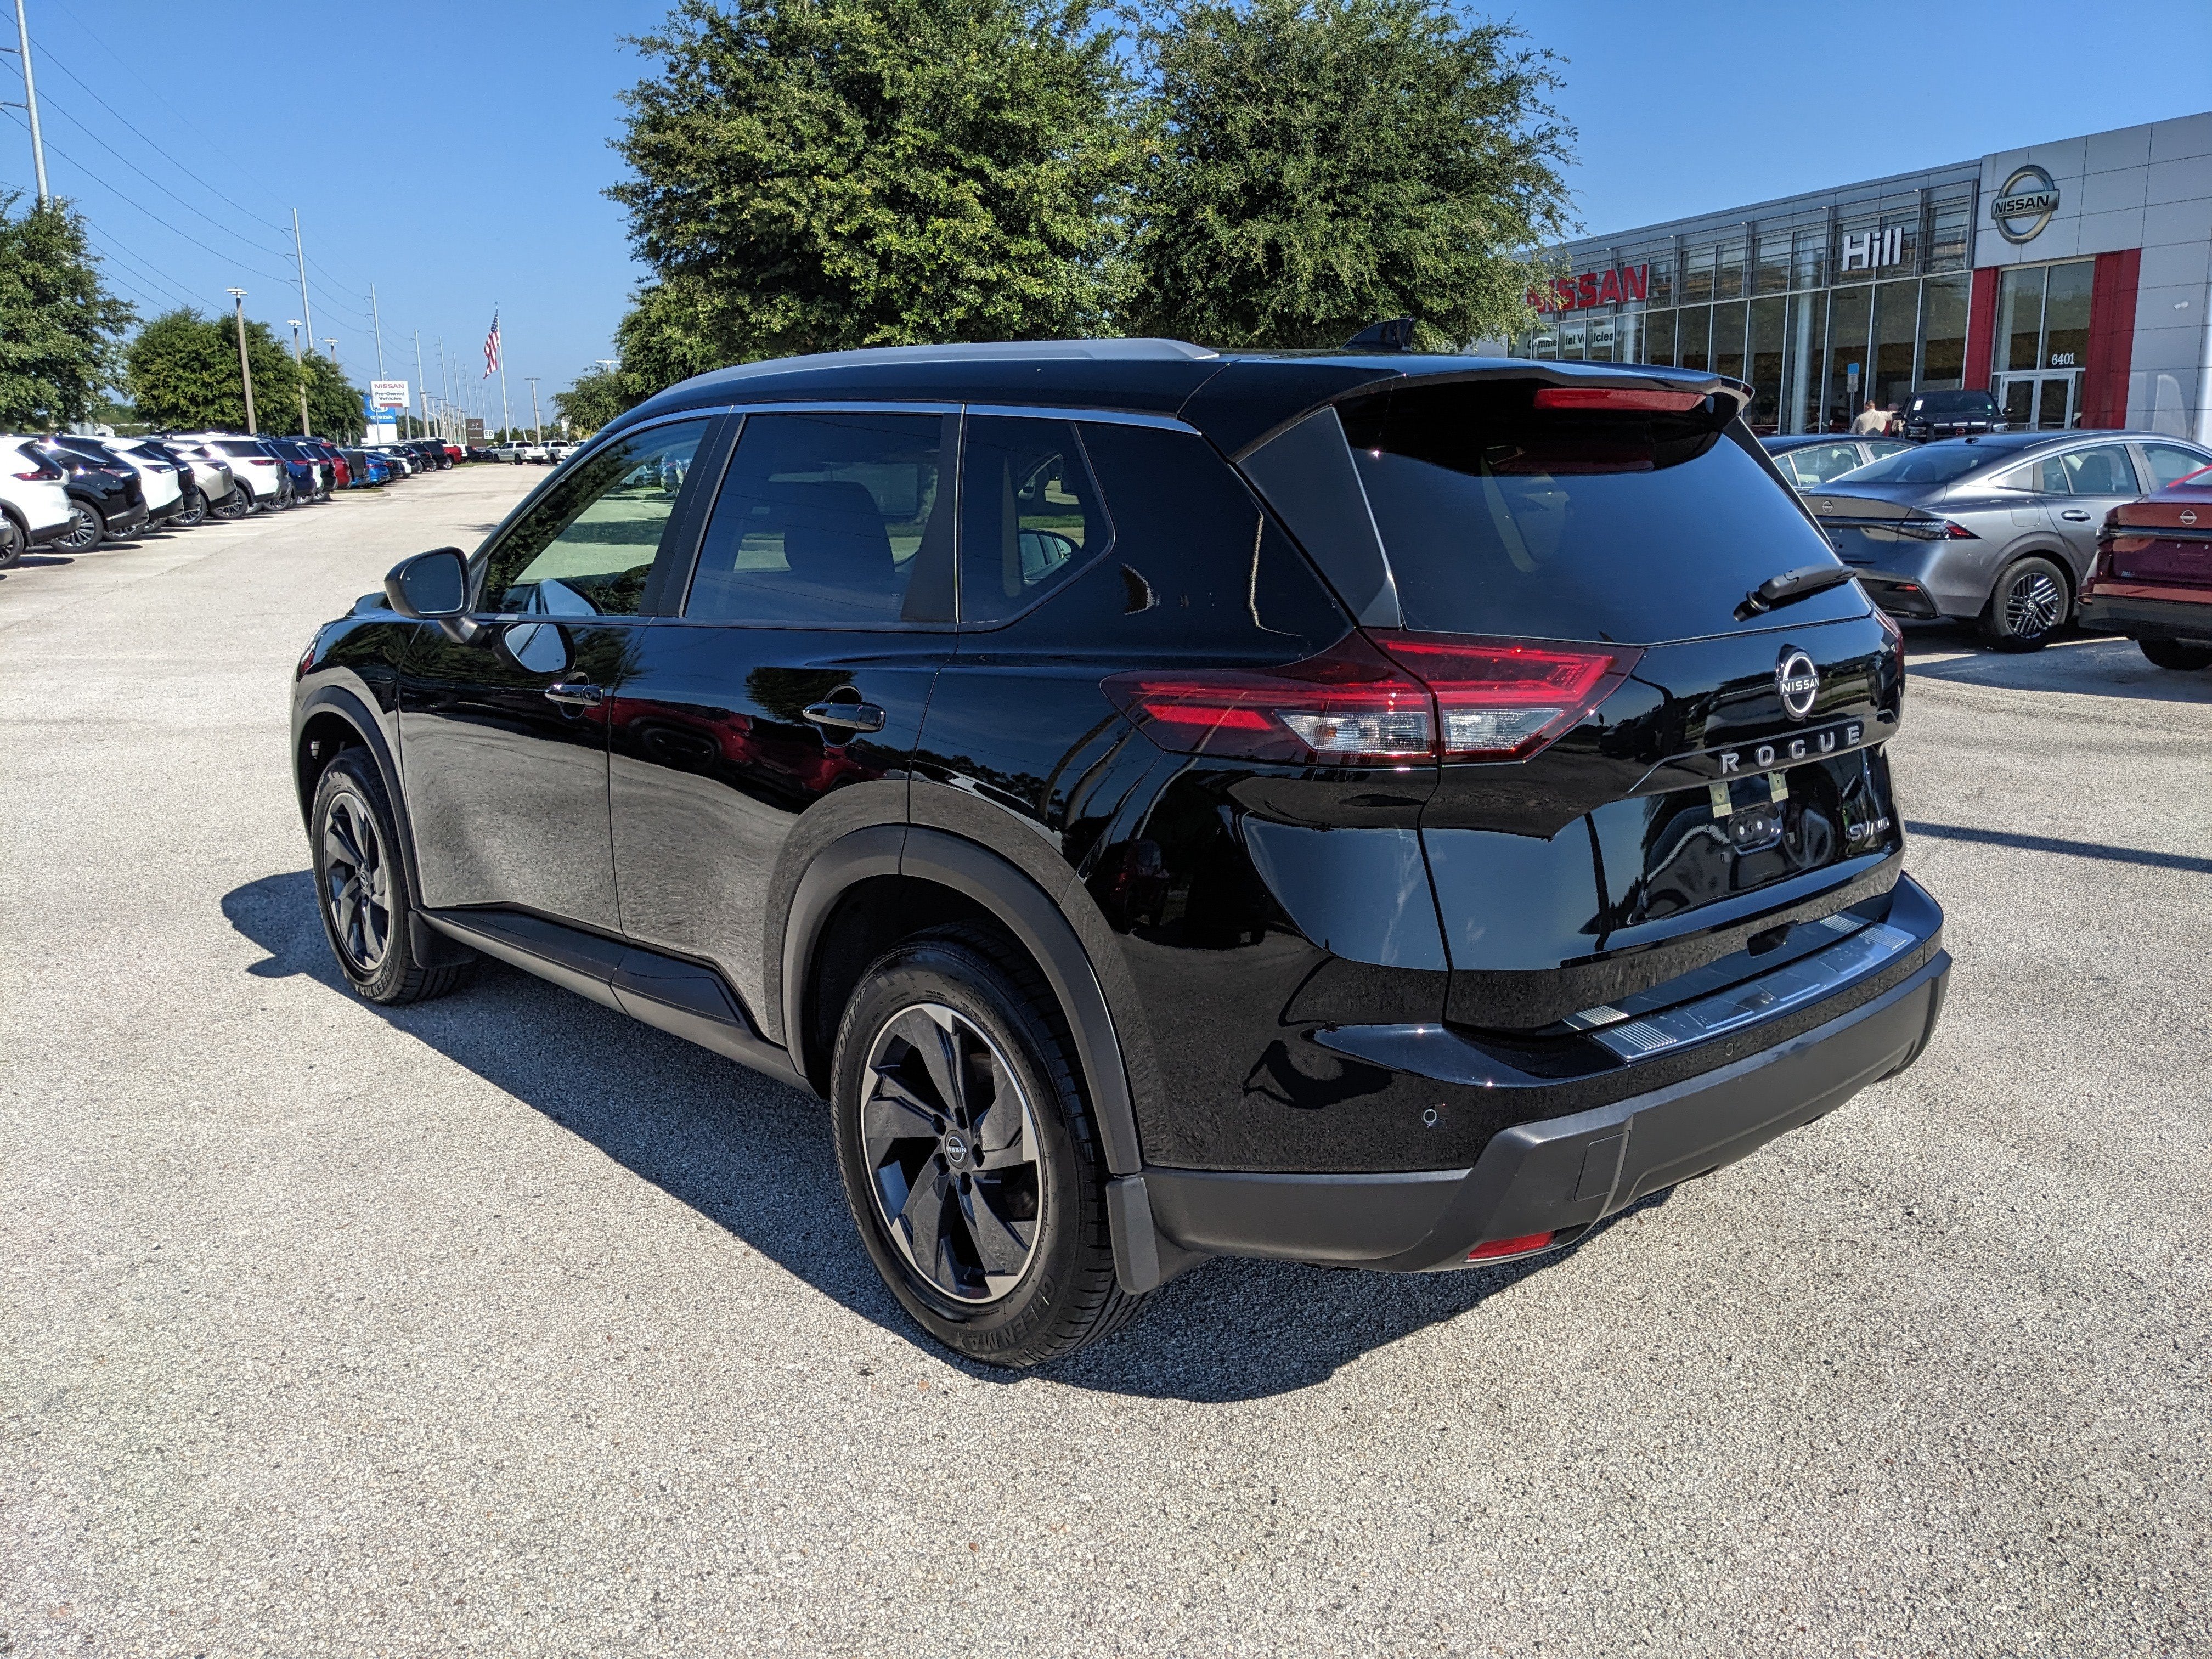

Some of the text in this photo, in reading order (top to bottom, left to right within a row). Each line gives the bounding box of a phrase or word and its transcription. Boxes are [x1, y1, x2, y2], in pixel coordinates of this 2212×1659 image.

[1995, 195, 2049, 214] NISSAN
[1842, 228, 1904, 272] Hill
[2052, 353, 2074, 365] 6401
[1781, 677, 1819, 692] NISSAN
[1720, 725, 1860, 774] ROGUE
